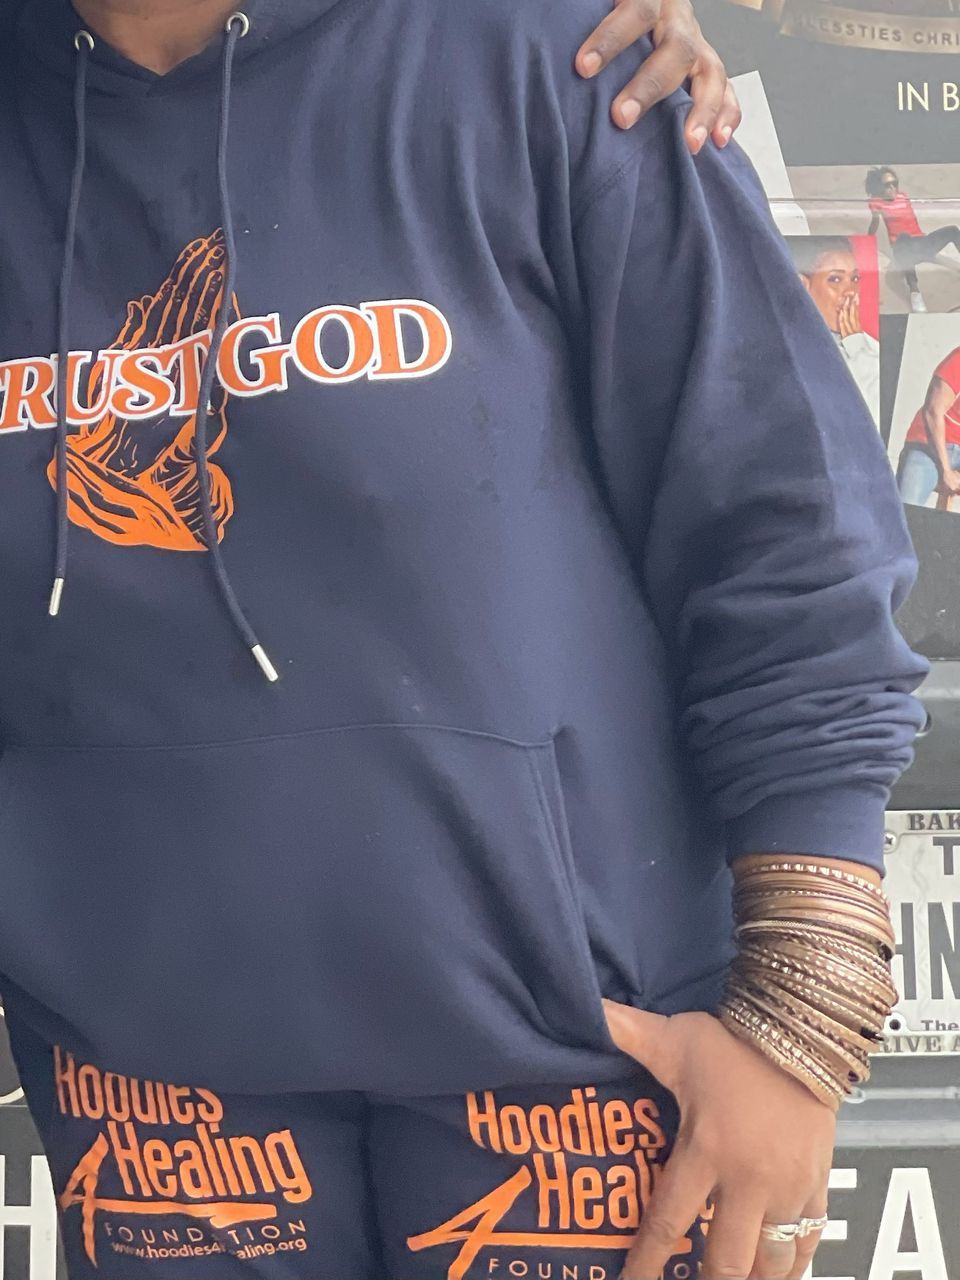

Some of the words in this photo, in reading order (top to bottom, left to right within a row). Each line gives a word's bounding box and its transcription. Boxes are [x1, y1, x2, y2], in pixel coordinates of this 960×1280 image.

[897, 81, 930, 111] IN
[215, 298, 453, 398] GOD
[920, 1019, 960, 1031] The
[466, 1086, 667, 1157] Hoodies
[106, 1118, 313, 1204] Healing
[104, 1219, 307, 1245] FOUNDTION
